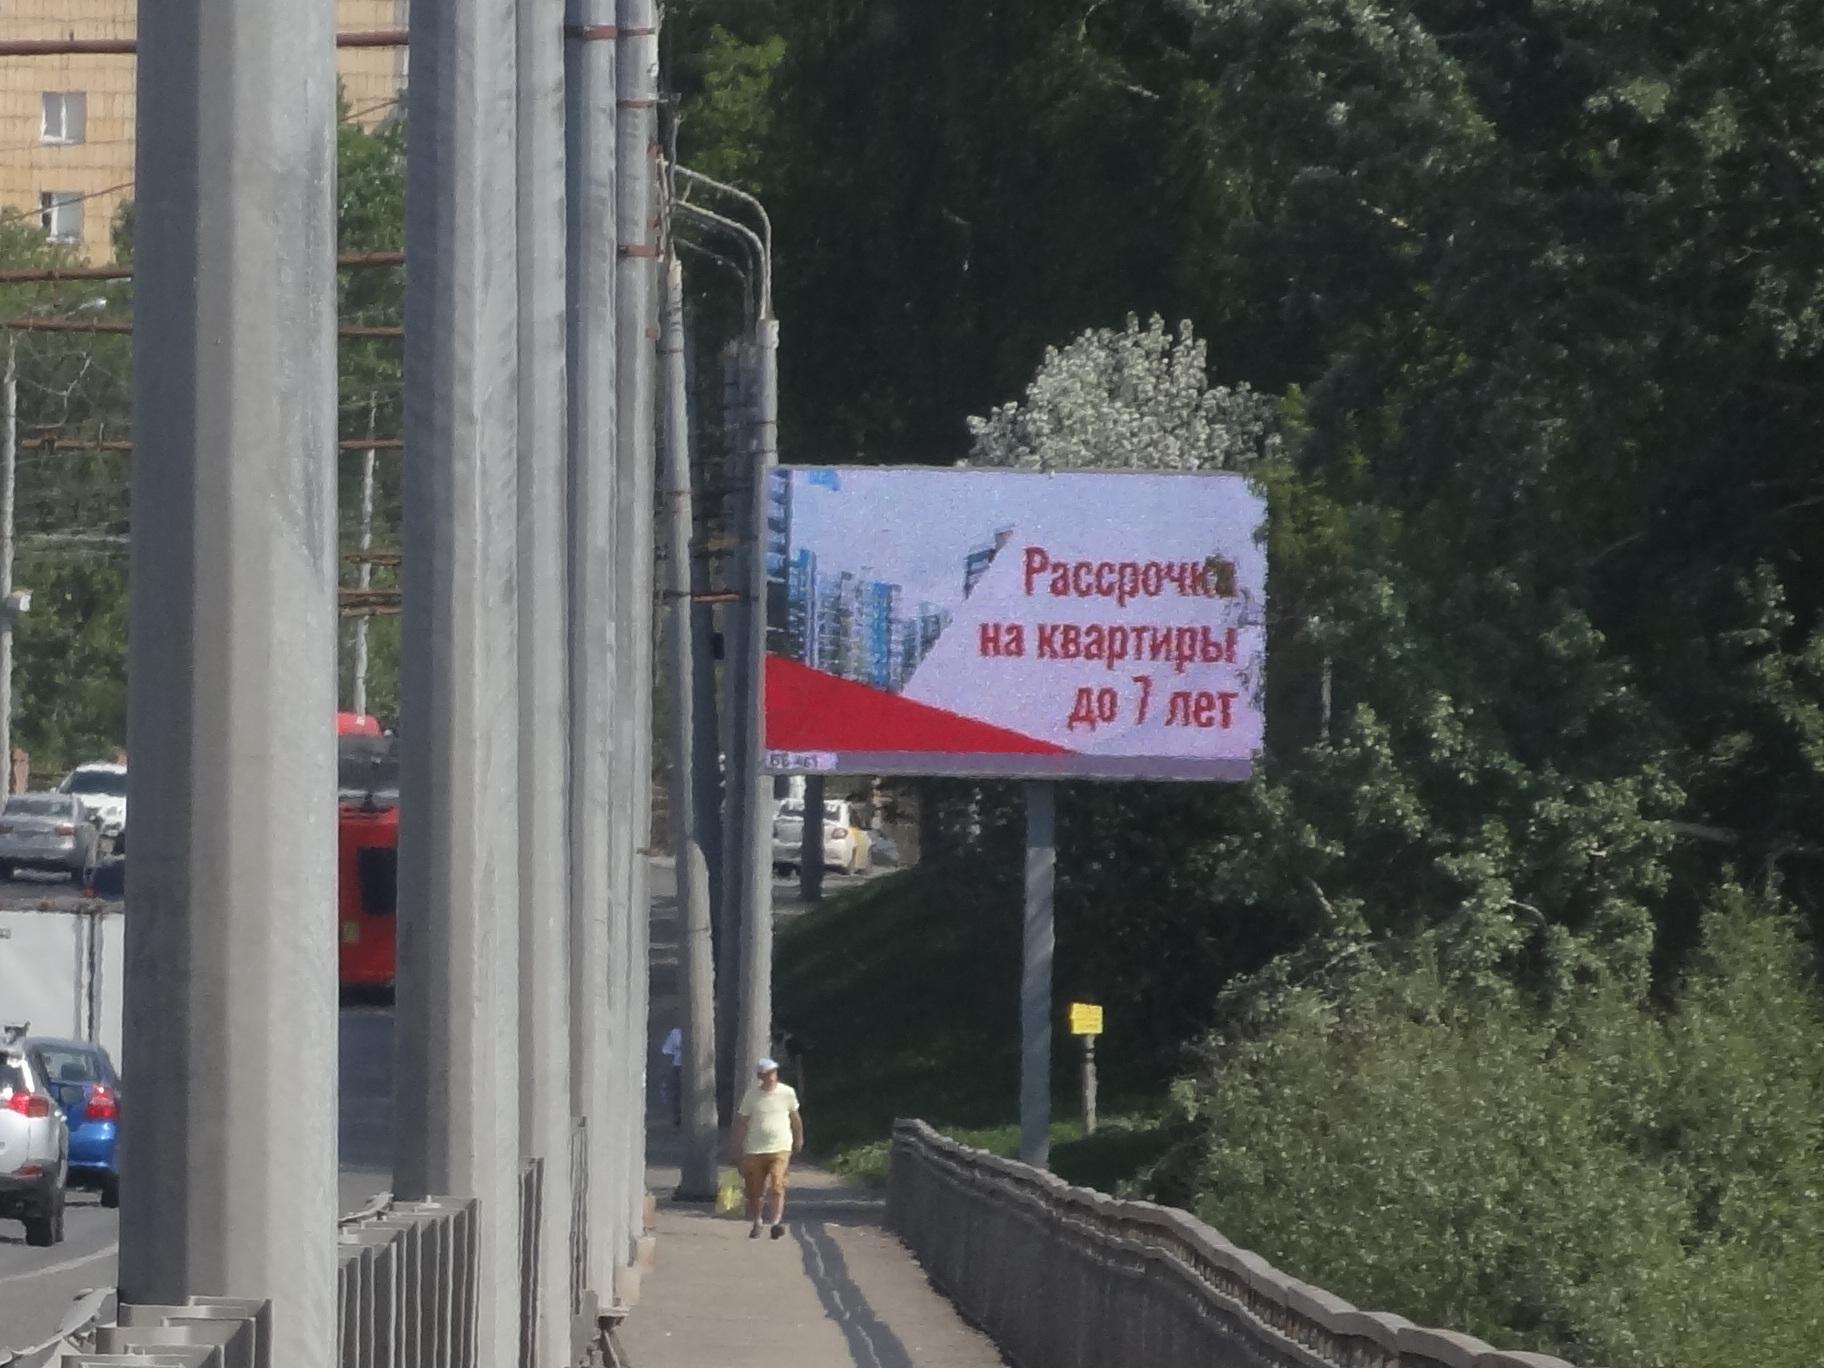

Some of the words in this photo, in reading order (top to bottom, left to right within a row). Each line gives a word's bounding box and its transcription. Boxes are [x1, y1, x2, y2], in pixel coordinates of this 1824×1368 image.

[1023, 546, 1237, 608] Рассрочк
[979, 622, 1024, 657] на
[1037, 622, 1239, 673] квартиры
[1067, 686, 1118, 732] до
[1133, 674, 1153, 725] 7
[1165, 690, 1240, 729] лет
